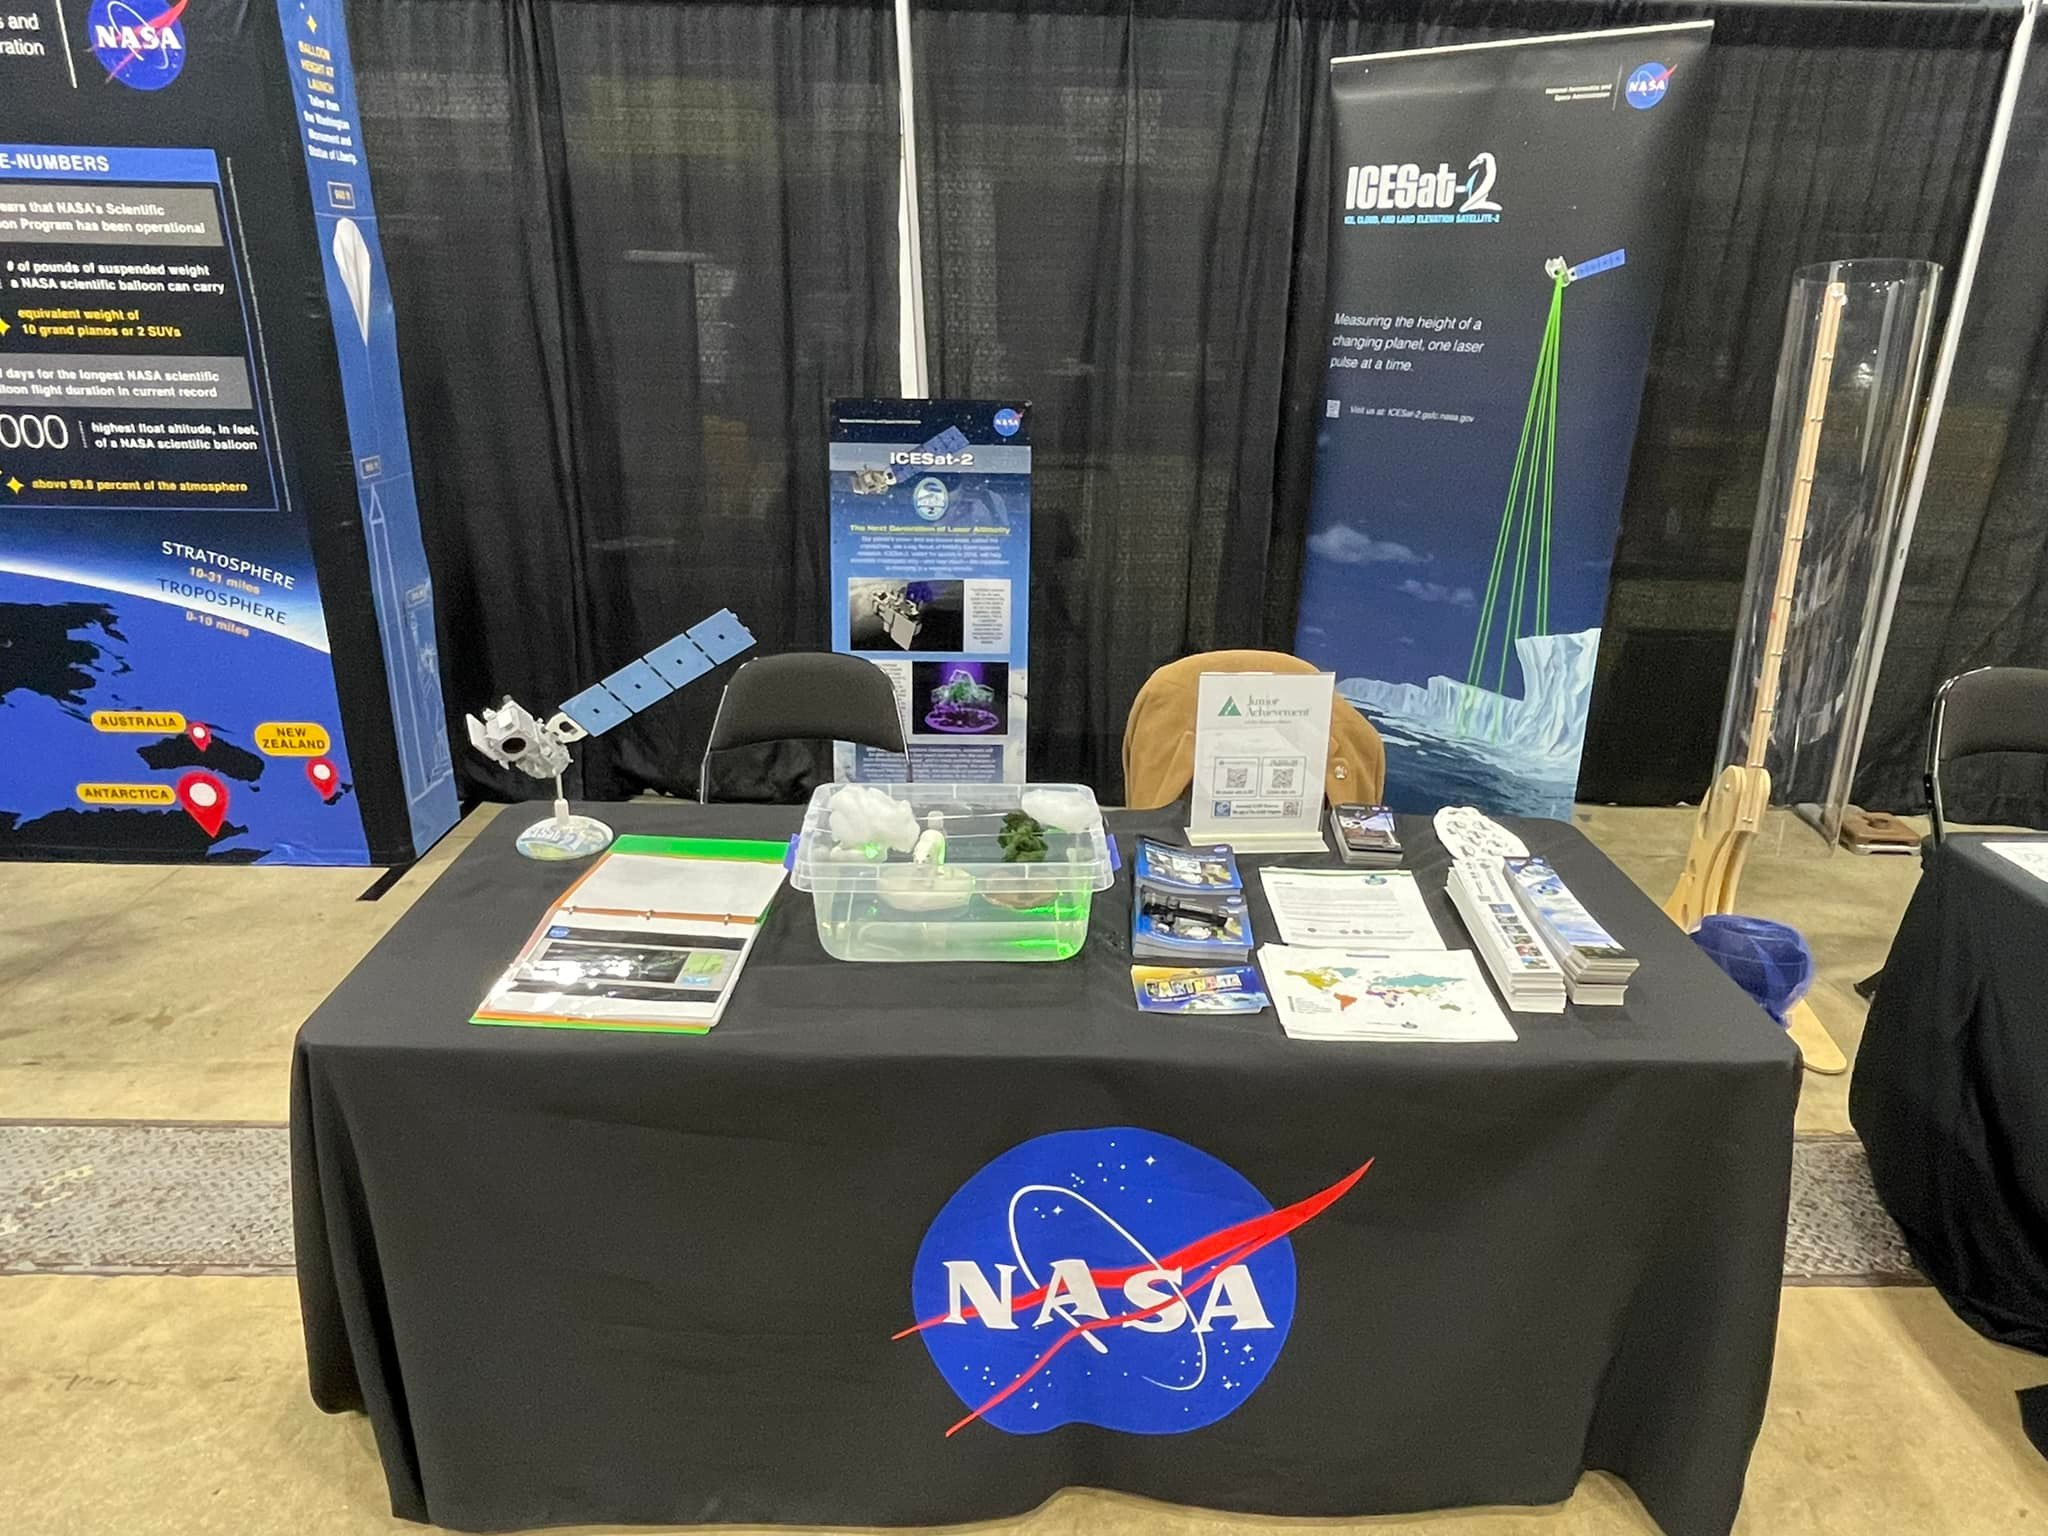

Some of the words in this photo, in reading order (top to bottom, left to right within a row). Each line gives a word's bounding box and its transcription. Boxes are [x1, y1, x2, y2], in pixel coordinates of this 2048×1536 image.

[8, 13, 40, 30] and
[95, 25, 182, 49] NASA
[1628, 80, 1665, 92] NASA
[0, 153, 110, 172] E-NUMBERS
[1346, 152, 1503, 213] ICESat-2
[28, 202, 55, 213] that
[56, 202, 104, 214] NASA's
[106, 203, 165, 216] Scientific
[20, 218, 74, 233] Program
[76, 220, 100, 231] has
[101, 220, 133, 232] been
[136, 222, 206, 235] operational
[18, 260, 31, 272] of
[33, 262, 80, 275] pounds
[82, 262, 95, 274] of
[98, 264, 166, 277] suspended
[168, 264, 210, 278] weight
[11, 279, 20, 289] a
[20, 278, 58, 290] NASA
[60, 279, 117, 290] scientific
[119, 280, 165, 291] balloon
[168, 282, 191, 292] can
[193, 283, 225, 295] carry
[18, 308, 81, 321] equivalent
[84, 309, 126, 323] weight
[128, 310, 140, 321] of
[1334, 313, 1393, 330] Measuring
[1395, 315, 1415, 328] the
[1416, 316, 1457, 332] height
[1458, 317, 1473, 330] of
[1473, 320, 1483, 331] a
[23, 324, 37, 335] 10
[39, 325, 75, 338] grand
[78, 326, 119, 338] pianos
[122, 328, 134, 337] or
[137, 326, 145, 337] 2
[148, 326, 182, 338] SUVs
[1332, 335, 1383, 351] changing
[1384, 337, 1425, 352] planet,
[1428, 341, 1452, 352] one
[1452, 340, 1485, 354] laser
[1330, 356, 1359, 369] pulse
[1360, 358, 1373, 369] at
[1374, 360, 1383, 370] a
[1385, 358, 1414, 372] time.
[6, 368, 35, 381] days
[37, 368, 54, 379] for
[57, 369, 77, 380] the
[79, 370, 124, 383] longest
[127, 370, 162, 382] NASA
[164, 371, 220, 382] scientific
[31, 384, 63, 398] flight
[66, 385, 116, 396] duration
[118, 387, 130, 396] in
[132, 387, 176, 397] current
[178, 386, 218, 398] record
[92, 422, 136, 436] highest
[140, 423, 166, 434] float
[168, 424, 216, 436] altitude,
[218, 424, 230, 434] in
[995, 418, 1019, 427] NASA
[0, 414, 69, 449] 000
[95, 437, 107, 449] of
[110, 440, 118, 449] a
[120, 438, 155, 449] NASA
[157, 440, 211, 450] scientific
[214, 440, 258, 450] balloon
[890, 452, 974, 466] ICESat-2
[32, 479, 67, 490] above
[97, 480, 141, 493] percent
[144, 480, 155, 491] of
[158, 481, 177, 491] the
[179, 482, 248, 494] atmosphere
[162, 541, 296, 590] STRATOSPHERE
[190, 566, 222, 585] 10-31
[226, 577, 261, 595] miles
[157, 578, 287, 625] TROPOSPHERE
[186, 611, 213, 627] 0-10
[216, 621, 249, 637] miles
[1247, 694, 1280, 706] Junior
[100, 716, 177, 728] AUSTRALIA
[276, 727, 307, 738] NEW
[262, 738, 326, 750] ZEALAND
[84, 788, 170, 800] ANTARCTICA
[942, 1258, 1275, 1334] NASA
